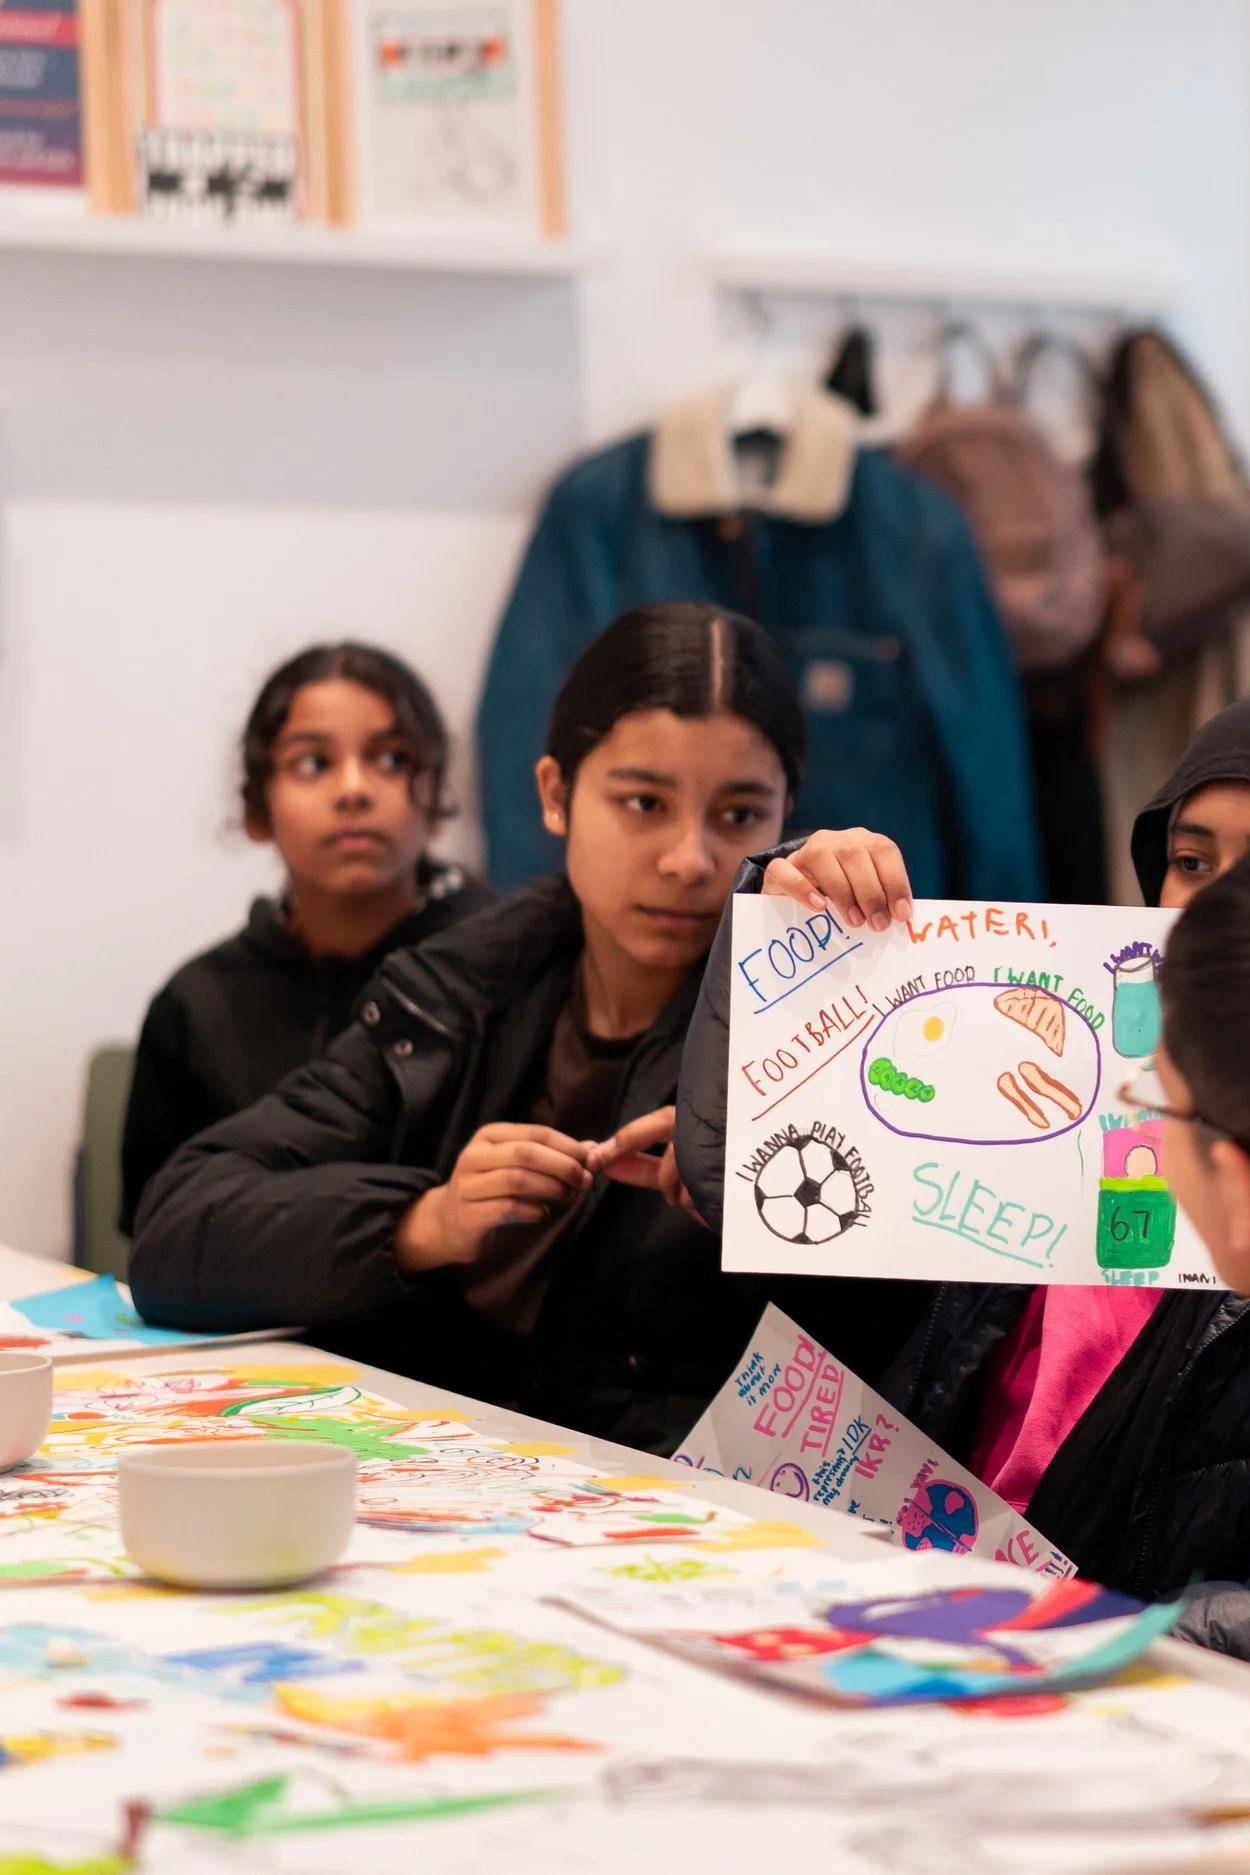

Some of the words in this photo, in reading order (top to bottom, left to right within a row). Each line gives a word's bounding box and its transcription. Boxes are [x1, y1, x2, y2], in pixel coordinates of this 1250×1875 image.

[906, 907, 1057, 948] WATER!
[738, 908, 850, 1002] FOOD!
[872, 1003, 887, 1018] I
[885, 975, 926, 1008] WANT
[934, 965, 976, 989] FOOD
[993, 966, 1001, 984] I
[1008, 969, 1064, 993] WANT
[1067, 987, 1106, 1031] FOOD
[741, 985, 869, 1097] FOOTBALL!
[742, 1123, 801, 1174] WANNA
[735, 1171, 754, 1182] I
[913, 1161, 1068, 1269] SLEEP!
[1110, 1205, 1150, 1242] 67
[1101, 1268, 1160, 1287] SLEEP
[800, 1363, 840, 1453] TIRED
[842, 1415, 869, 1450] IDK
